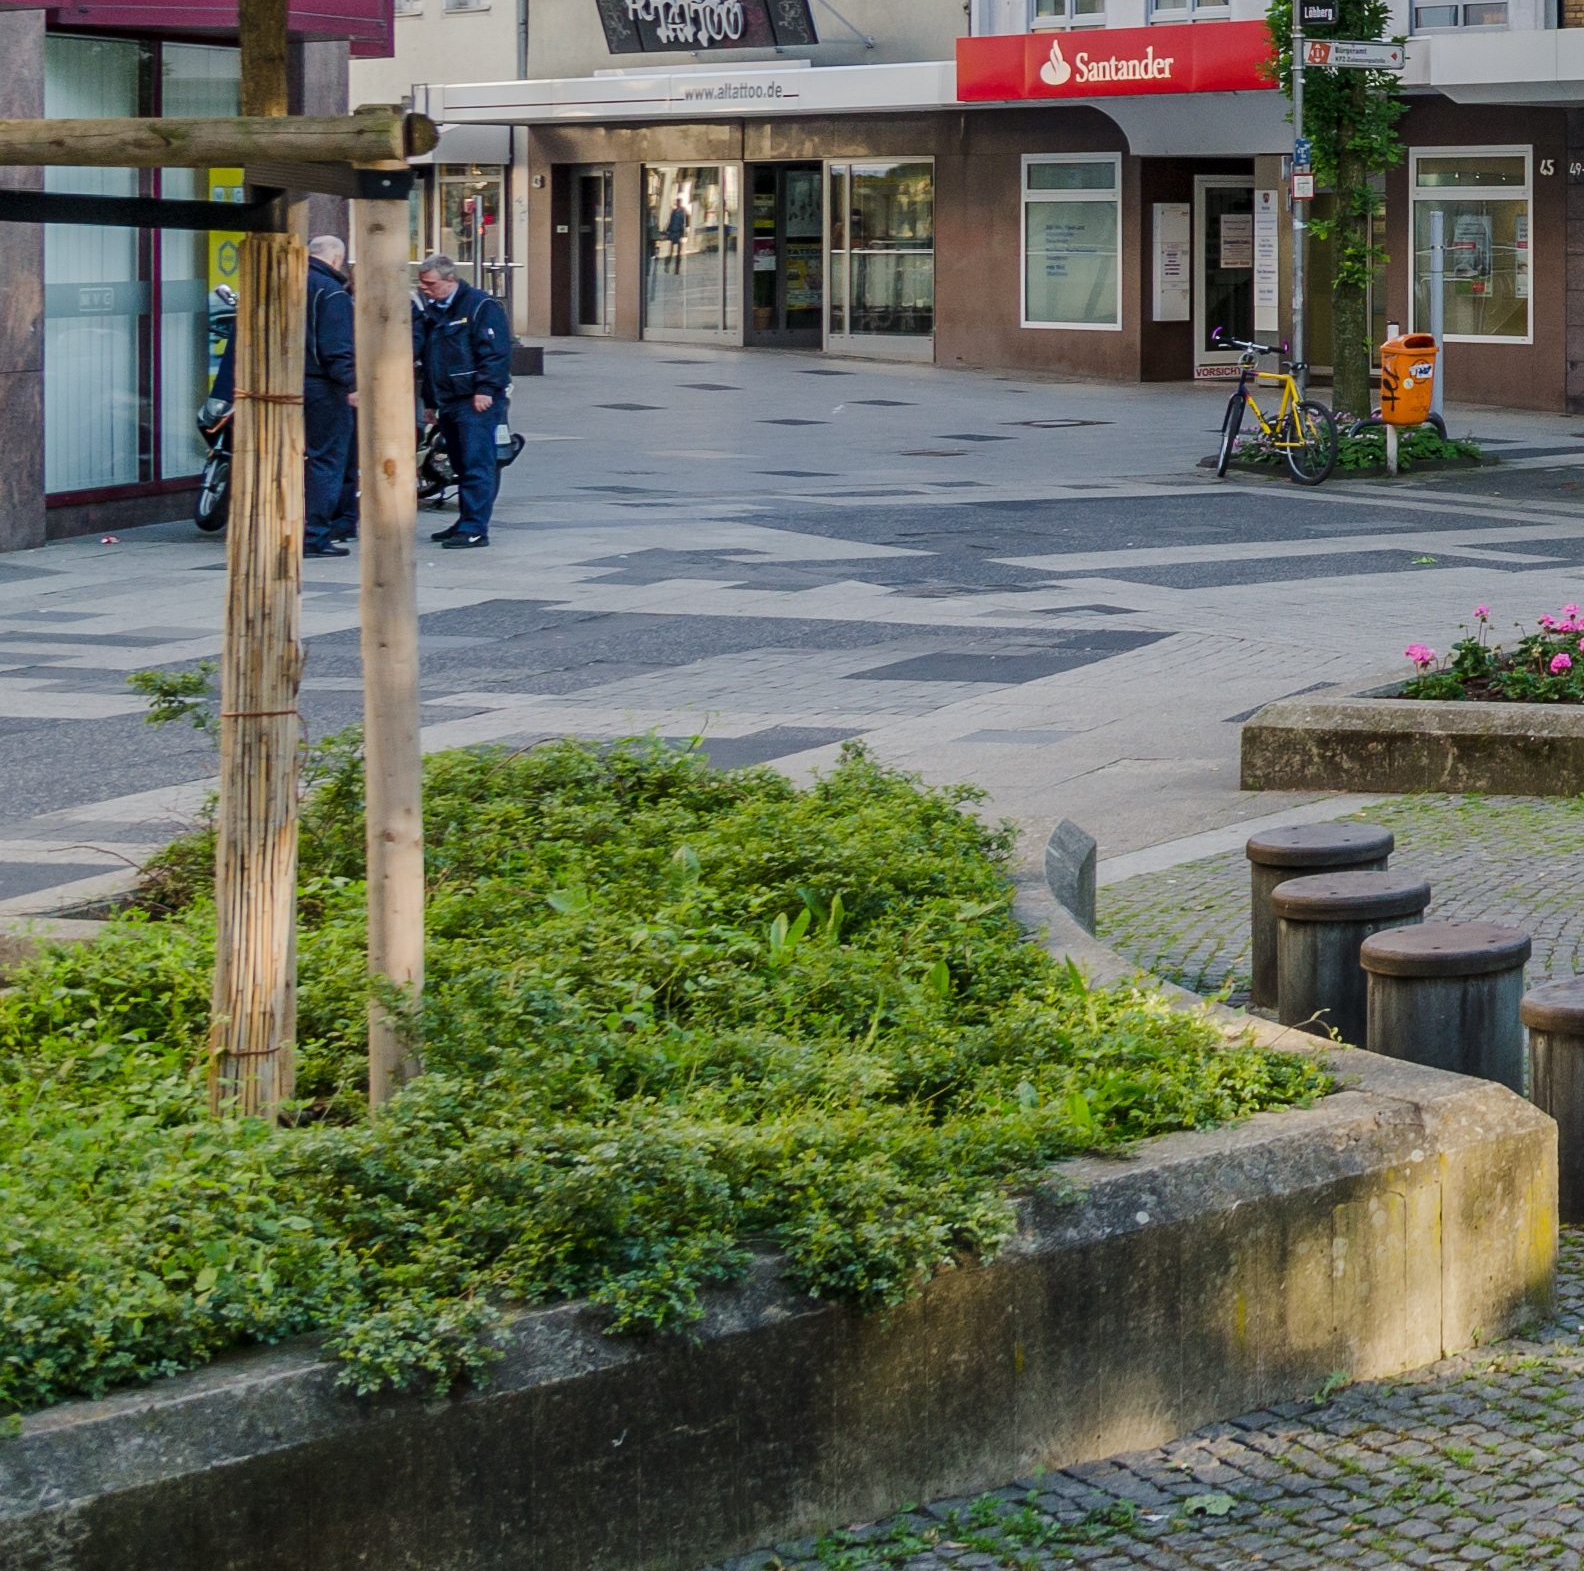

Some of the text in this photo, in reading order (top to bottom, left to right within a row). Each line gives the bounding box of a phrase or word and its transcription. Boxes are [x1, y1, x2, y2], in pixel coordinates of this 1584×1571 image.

[1304, 6, 1333, 21] Löhberg
[1075, 45, 1174, 83] Santander
[684, 81, 783, 101] www.altattoo.de
